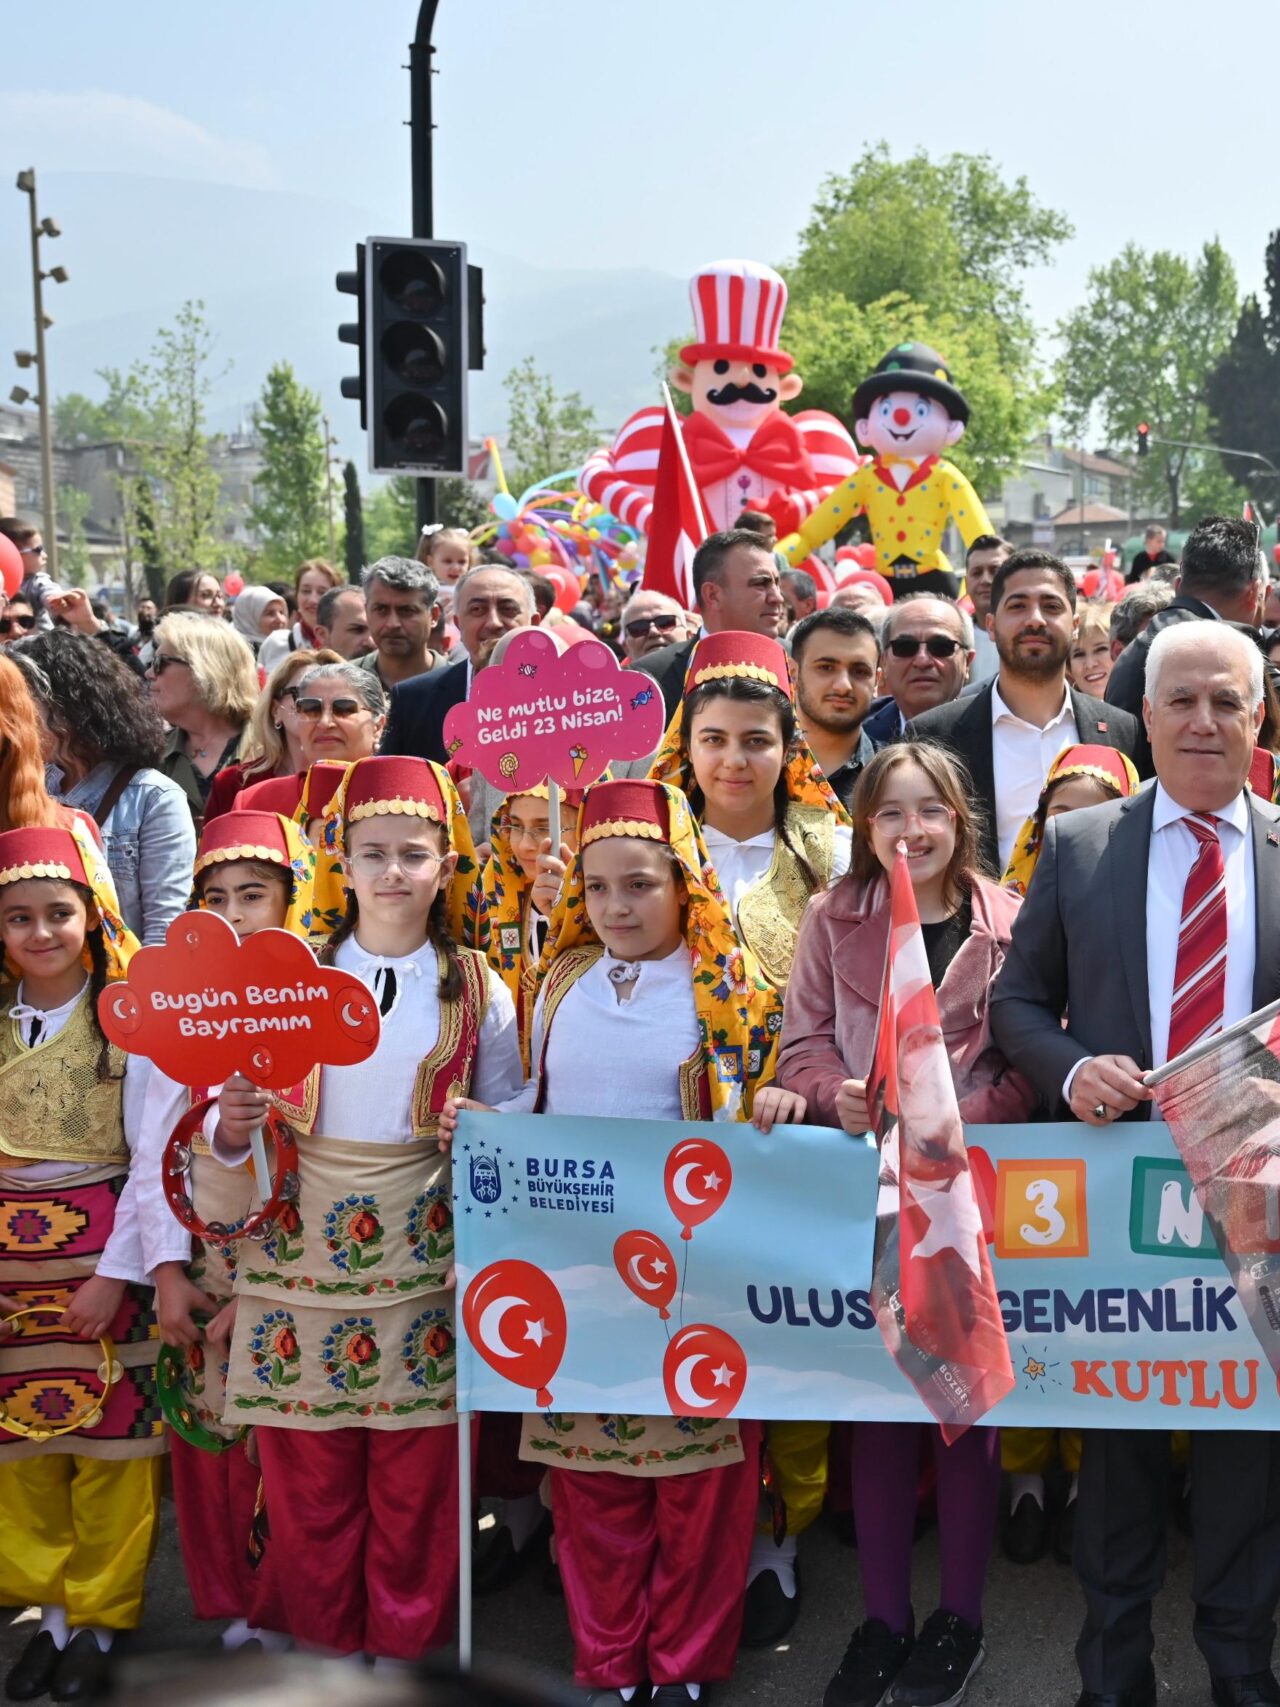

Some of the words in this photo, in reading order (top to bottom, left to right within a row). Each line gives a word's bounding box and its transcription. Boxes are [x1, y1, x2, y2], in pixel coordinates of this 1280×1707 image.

[477, 708, 503, 724] Ne
[508, 695, 567, 719] mutlu
[573, 687, 621, 707] bize,
[478, 719, 528, 746] Geldi
[534, 716, 556, 736] 23
[561, 703, 623, 731] Nisan!
[150, 988, 238, 1014] Bugün
[245, 981, 329, 1005] Benim
[178, 1013, 311, 1040] Bayramım
[526, 1157, 615, 1179] BURSA
[527, 1177, 614, 1197] BÜYÜKŞEHİR
[529, 1196, 614, 1214] BELEDİYESİ
[1020, 1179, 1066, 1246] 3
[746, 1284, 876, 1330] ULUS
[999, 1277, 1239, 1333] GEMENLİK
[939, 1363, 970, 1409] BOZBEY
[1071, 1359, 1260, 1410] KUTLU
